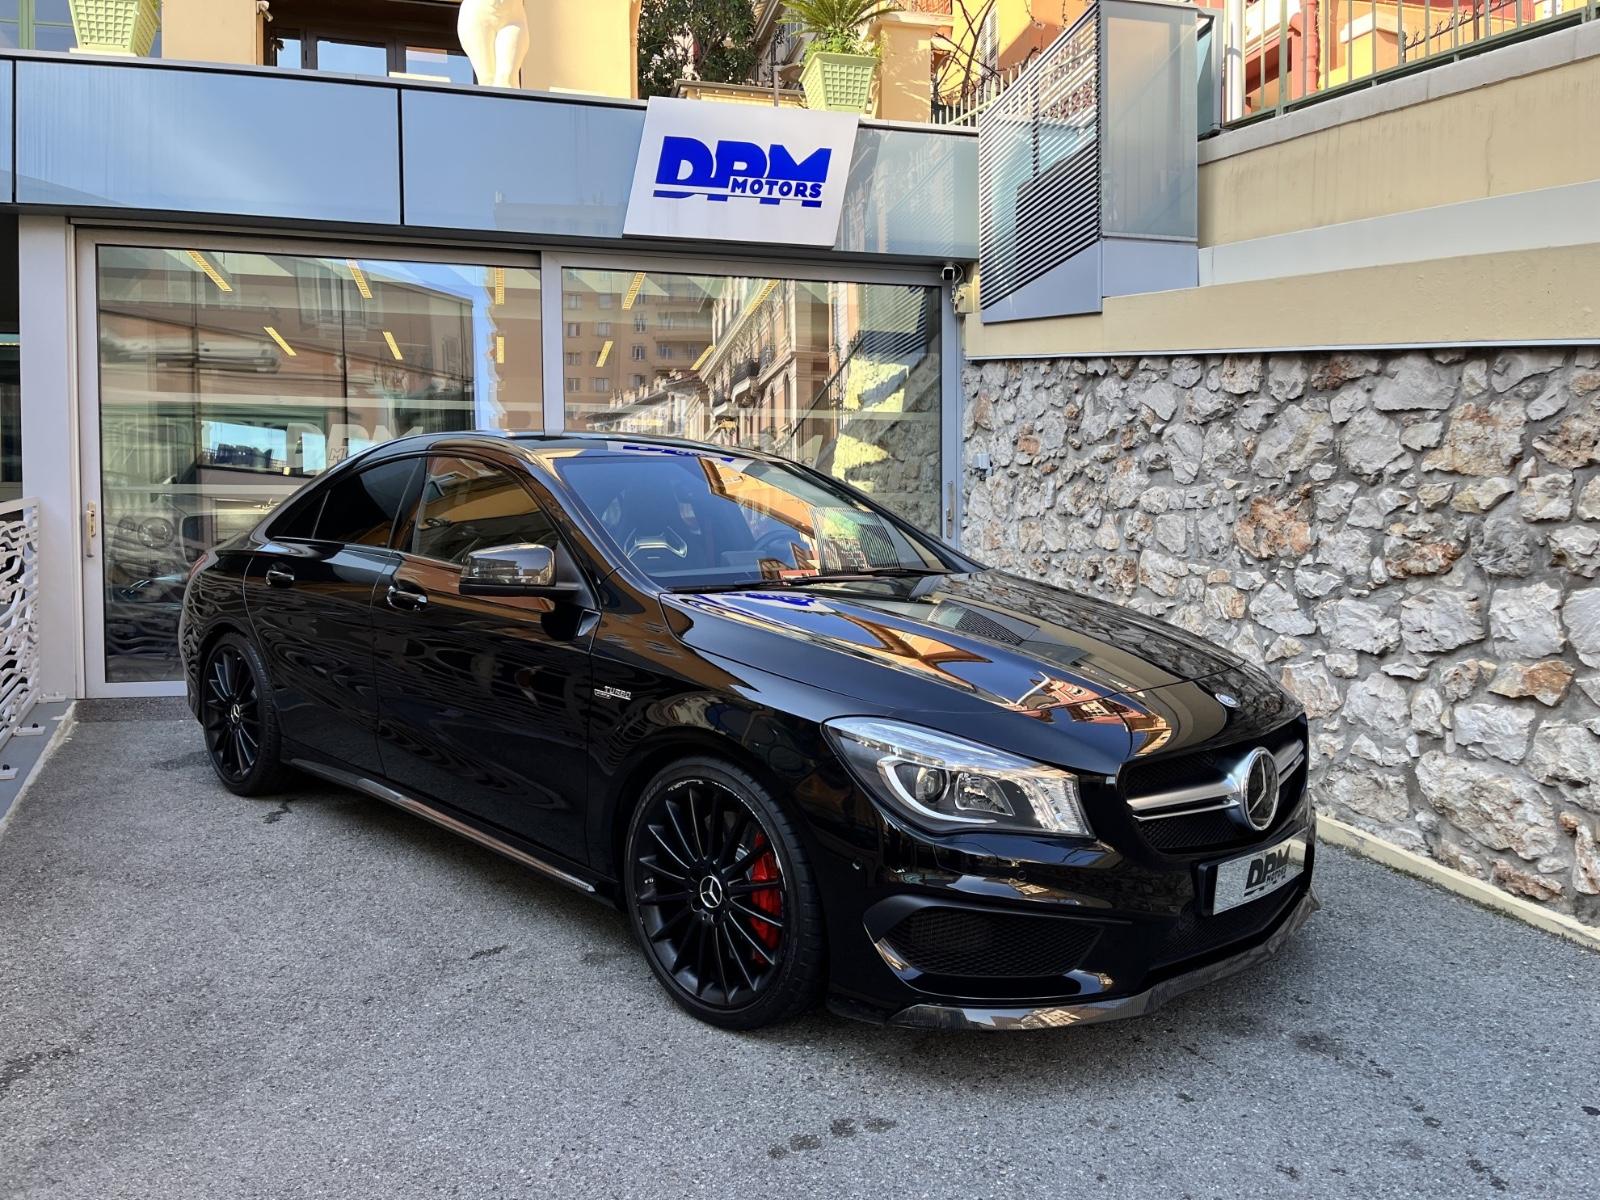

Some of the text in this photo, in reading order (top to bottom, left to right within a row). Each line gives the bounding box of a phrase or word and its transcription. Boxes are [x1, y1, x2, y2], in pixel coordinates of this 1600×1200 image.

[653, 136, 832, 208] DPM
[730, 177, 823, 199] MOTORS
[604, 685, 631, 699] TURBO
[1243, 843, 1291, 897] DPM
